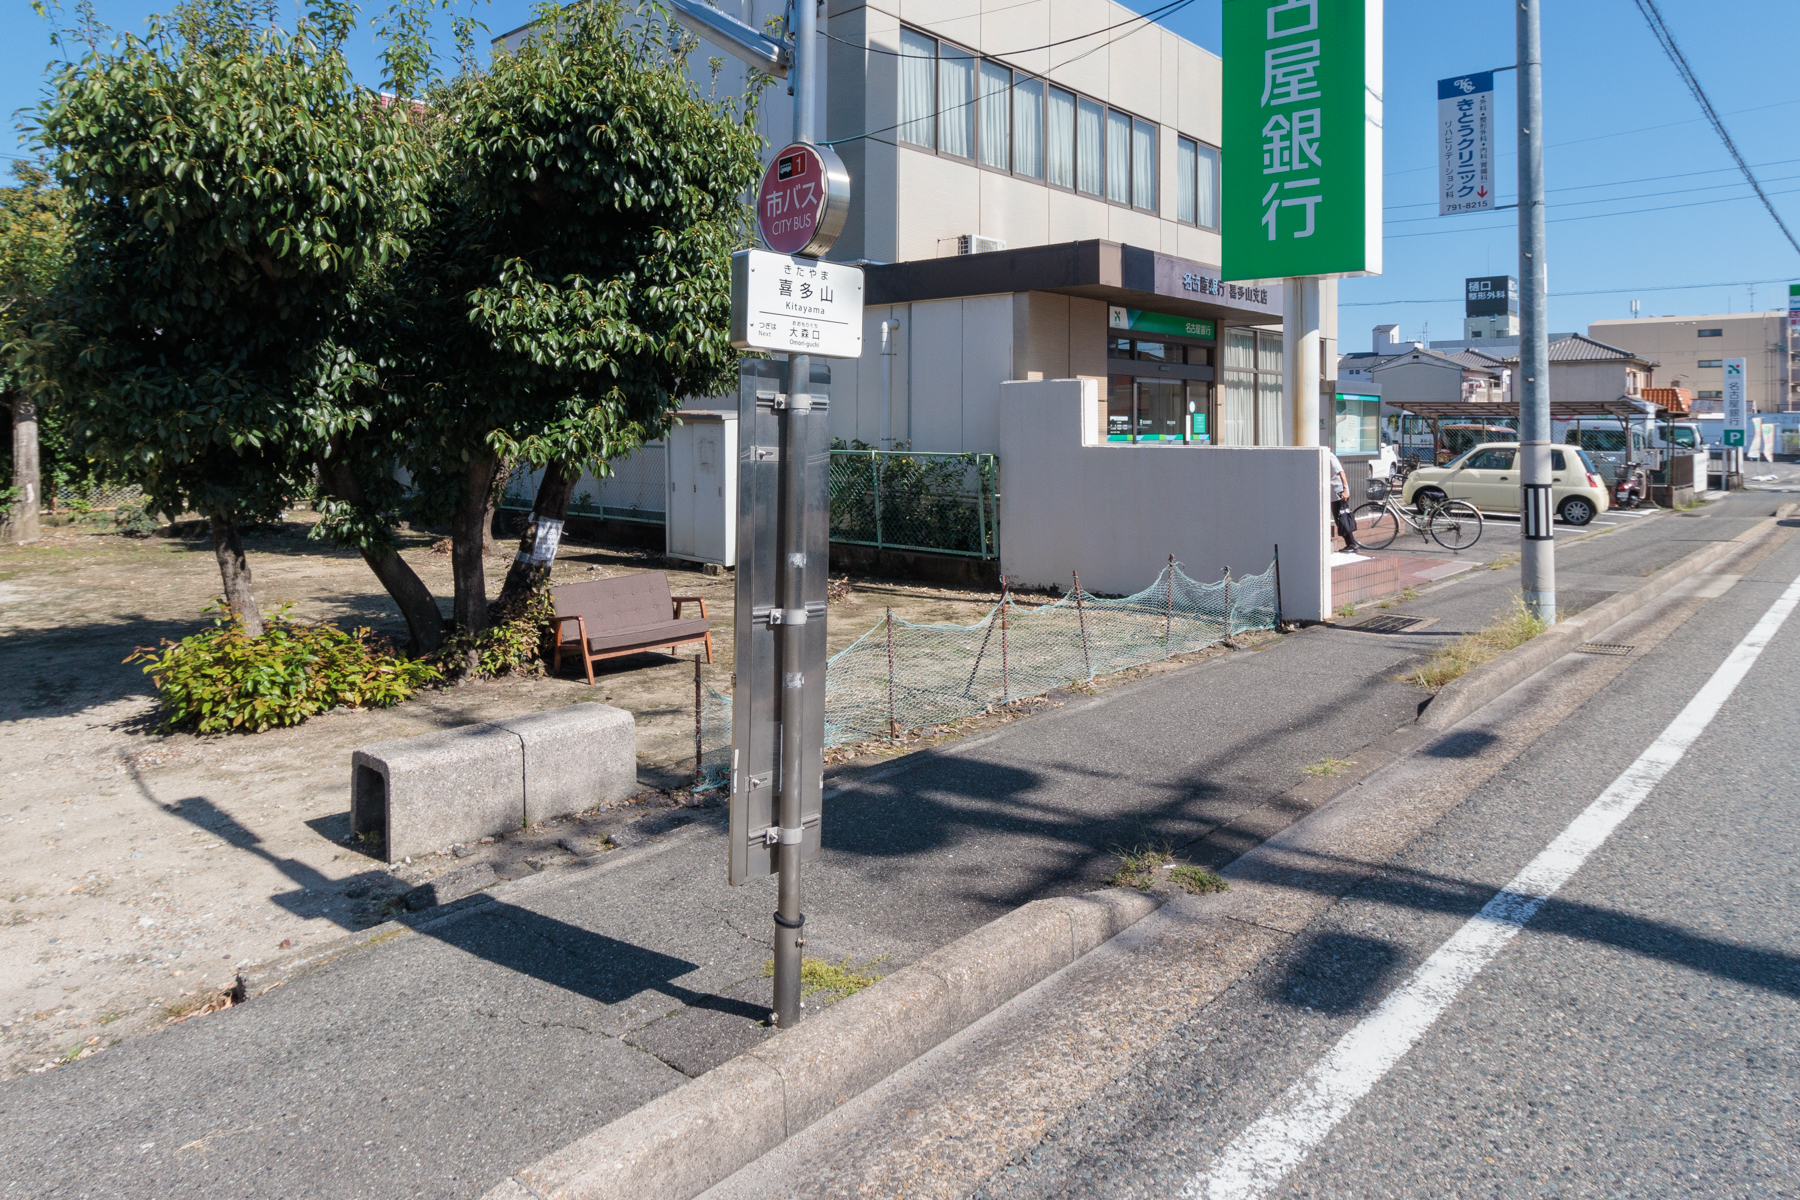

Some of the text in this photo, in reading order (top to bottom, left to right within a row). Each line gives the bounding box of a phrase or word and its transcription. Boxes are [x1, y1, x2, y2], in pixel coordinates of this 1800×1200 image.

[1456, 98, 1475, 198] きとうクリニック
[796, 156, 801, 172] 1
[1444, 120, 1454, 199] リハビリテーション科
[765, 181, 818, 218] 市バス
[1446, 200, 1488, 212] 791-8215
[771, 213, 812, 236] CITY BUS
[784, 264, 829, 281] きたやま
[778, 278, 834, 304] 喜多山
[1182, 272, 1268, 305] 名古屋銀行 喜多山支店
[1468, 290, 1506, 301] 整形外科
[785, 301, 825, 315] Kitayama
[759, 322, 777, 331] つぎは
[792, 320, 818, 329] おおもりぐち
[1185, 322, 1211, 336] 名古屋銀行
[758, 330, 772, 338] Next
[789, 326, 820, 341] 大森口
[789, 338, 820, 348] Omori-guchi
[1728, 382, 1740, 426] 名古屋銀行
[1730, 432, 1741, 444] P
